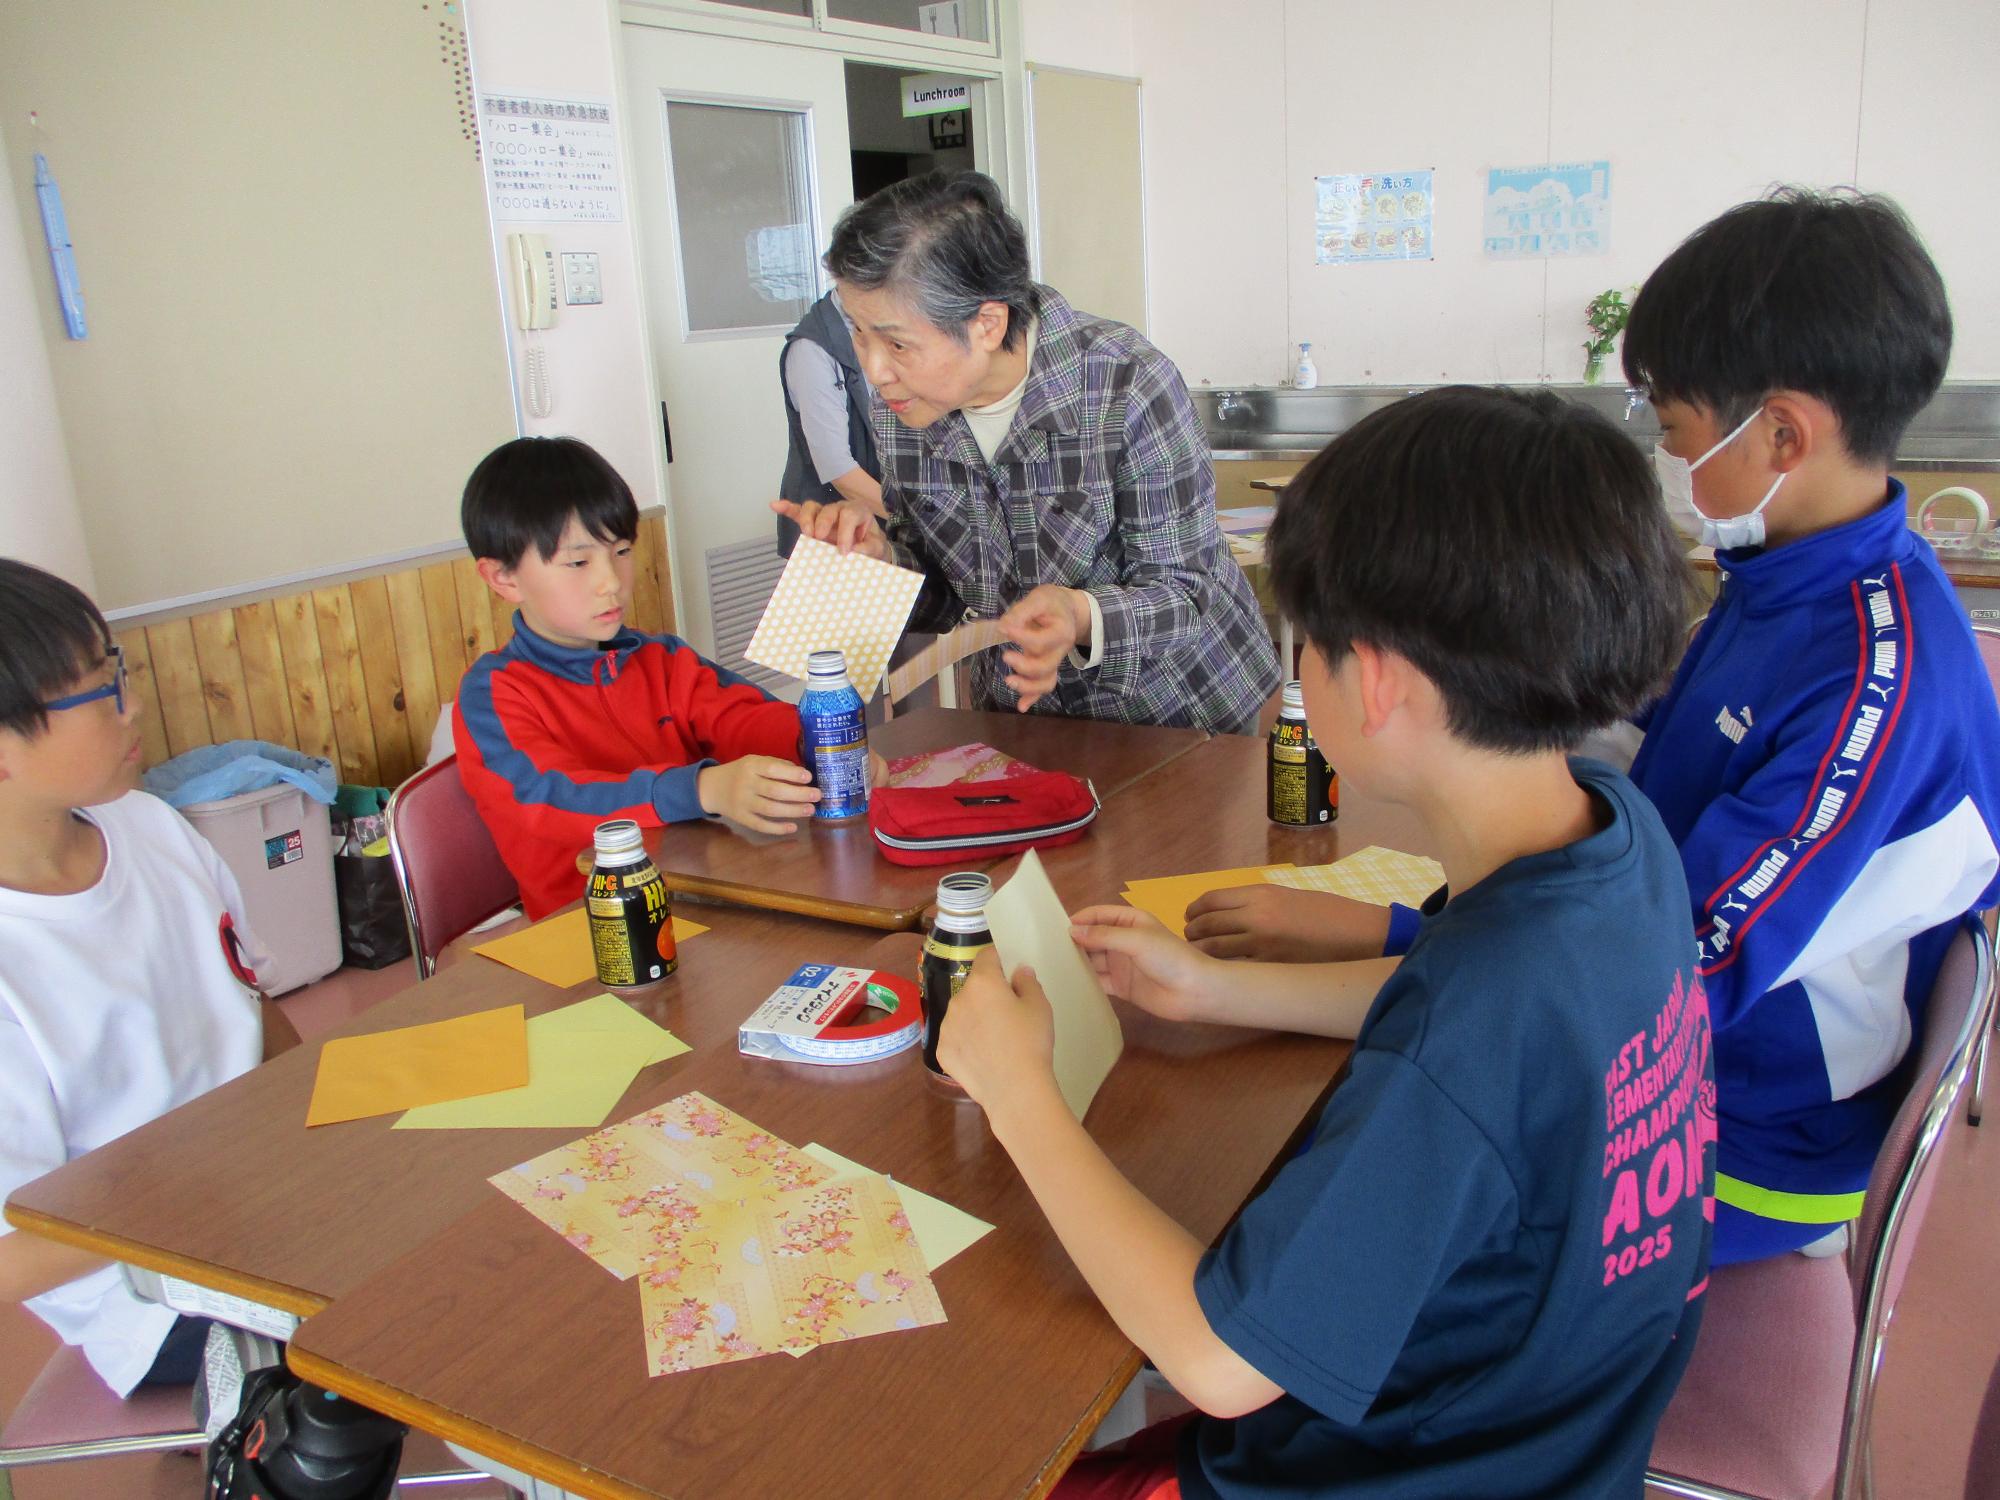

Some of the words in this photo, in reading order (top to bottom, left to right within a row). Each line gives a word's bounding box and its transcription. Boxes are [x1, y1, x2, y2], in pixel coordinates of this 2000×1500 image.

[484, 99, 609, 120] 不審者侵入時の緊急放送
[914, 86, 966, 103] Lunchroom
[1868, 590, 1895, 628] PUMA
[1873, 640, 1896, 680] PUMA
[1278, 737, 1301, 746] オレンジ
[1841, 705, 1883, 761] PUMA
[1802, 786, 1847, 839] PUMA
[288, 836, 300, 848] 25
[1738, 849, 1790, 899] PUMA
[649, 908, 670, 924] オレ
[796, 980, 840, 1024] ナイスタック
[1602, 1224, 1672, 1287] 2025
